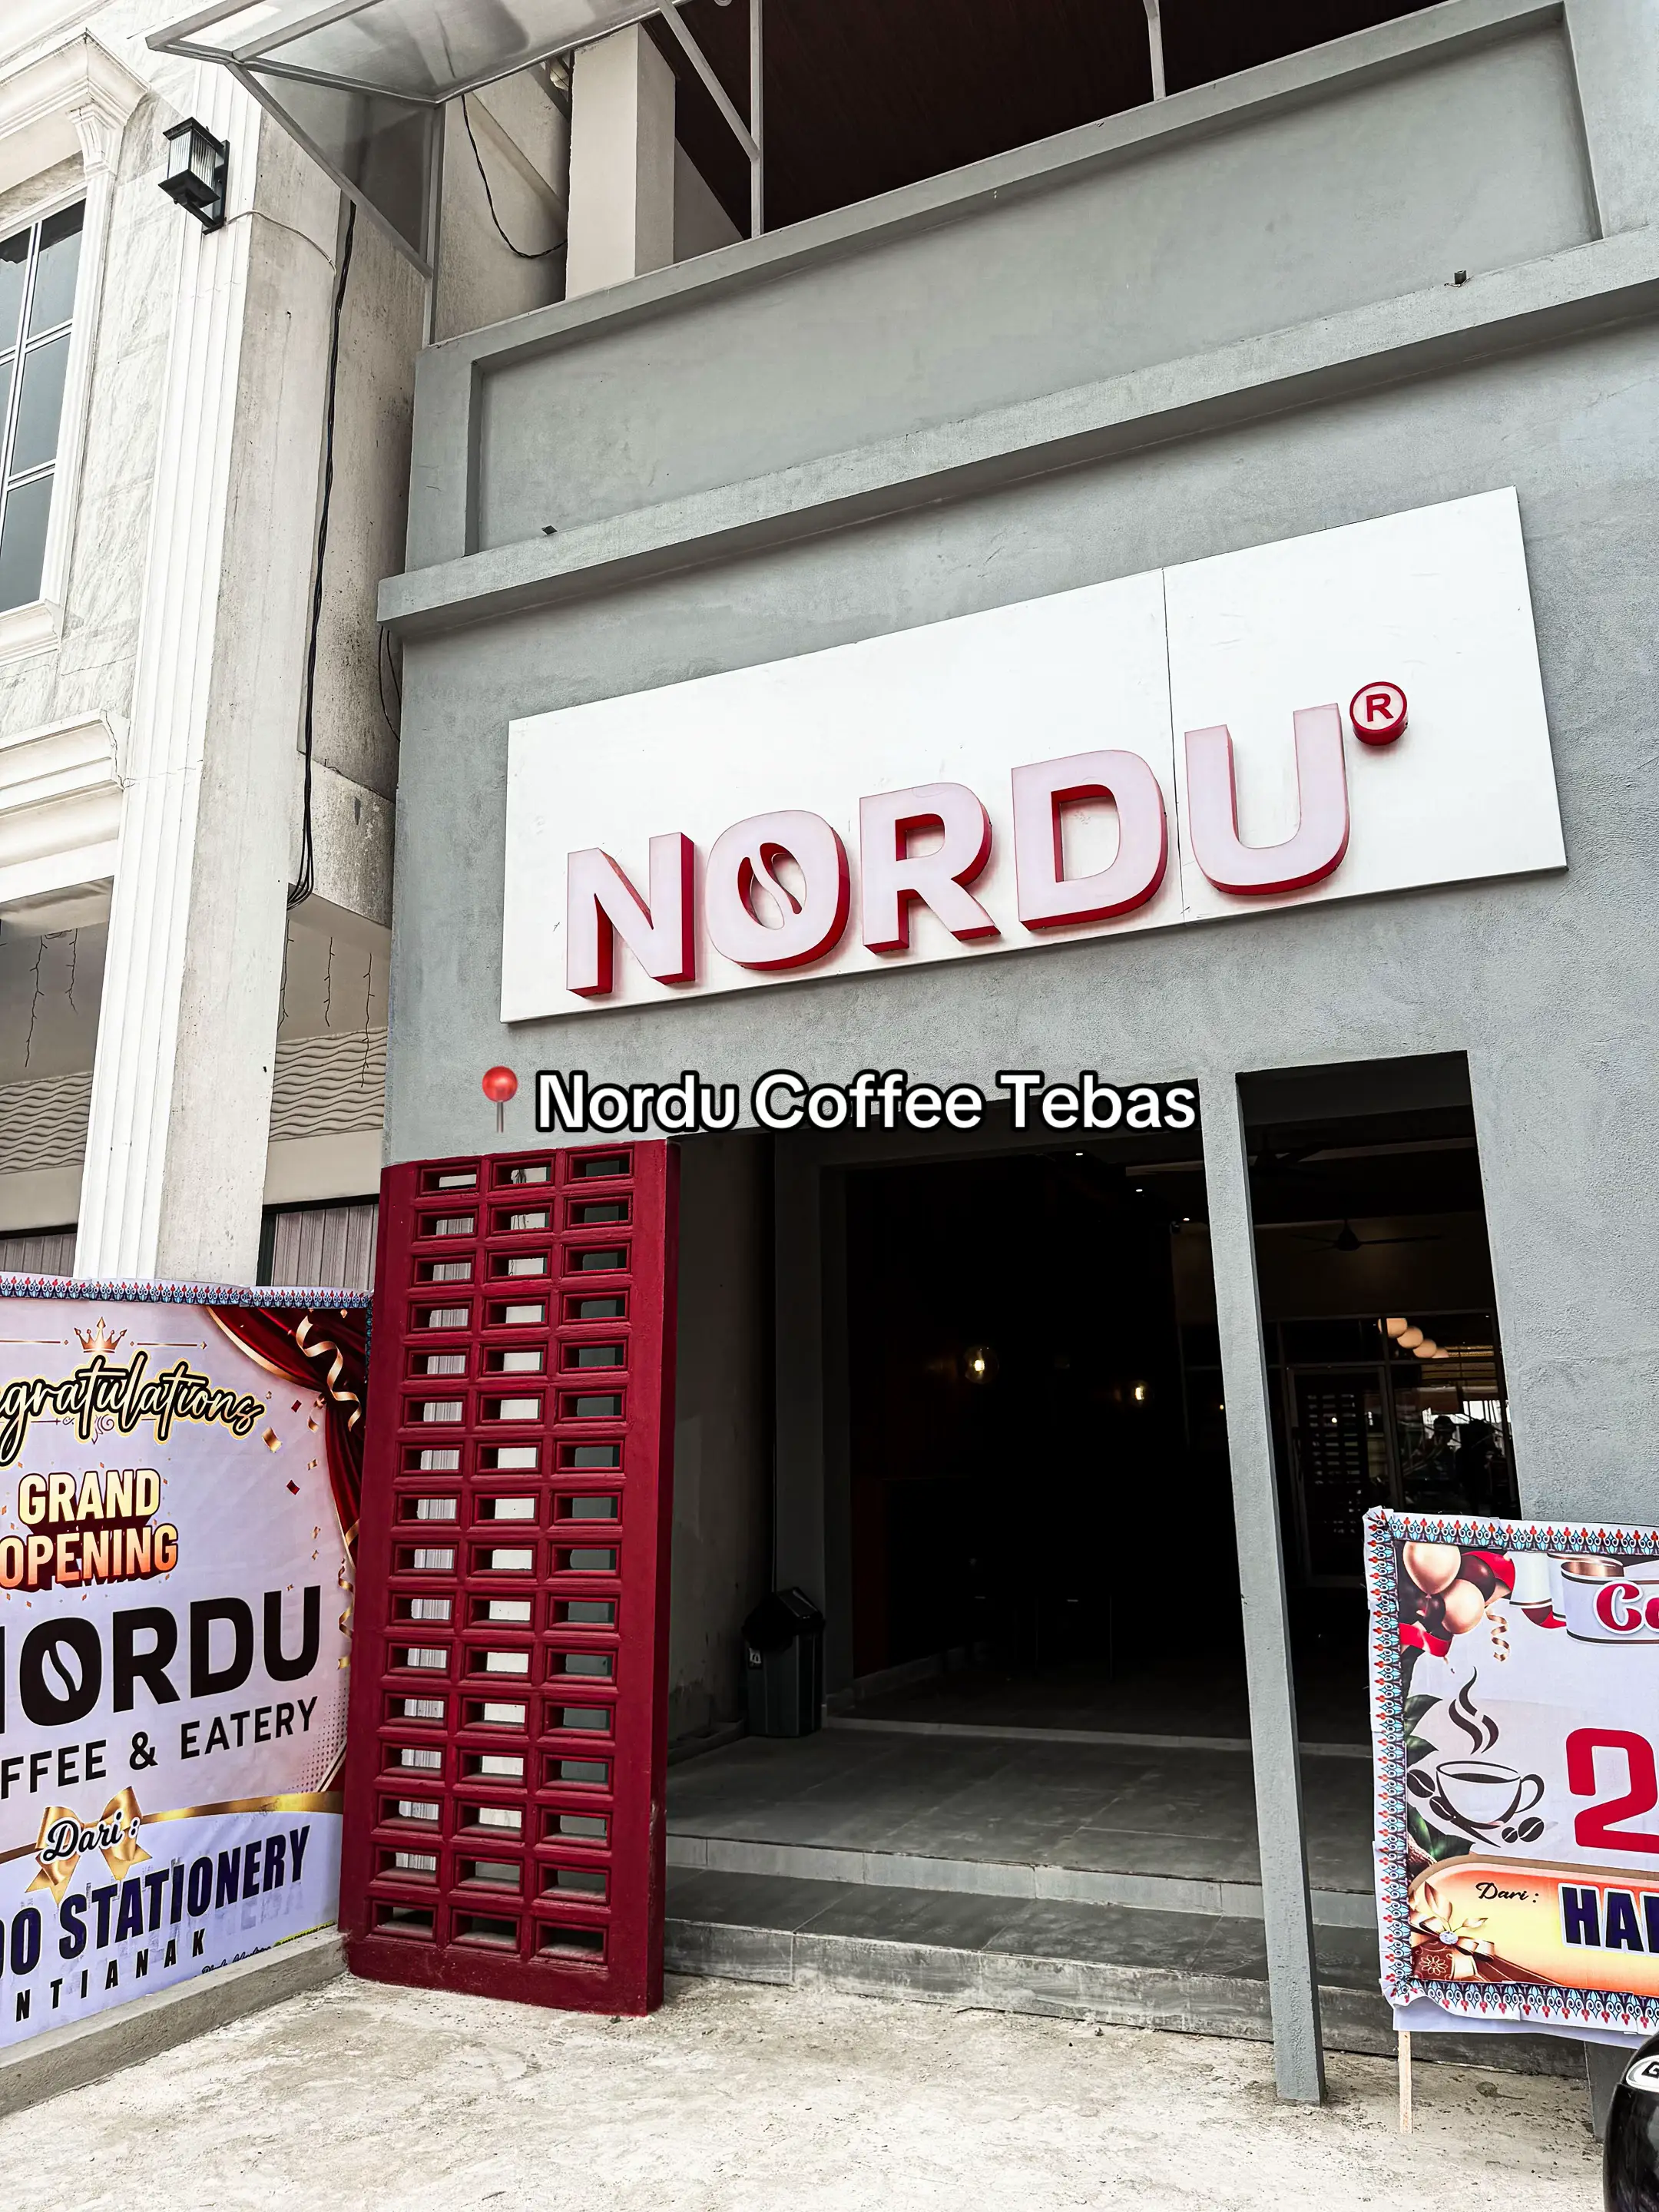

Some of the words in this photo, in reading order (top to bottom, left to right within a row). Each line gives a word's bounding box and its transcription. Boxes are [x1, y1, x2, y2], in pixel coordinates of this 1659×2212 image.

[566, 701, 1350, 997] NORDU
[18, 1469, 161, 1528] GRAND
[0, 1523, 179, 1591] OPENING
[0, 1585, 321, 1734] ORDU
[1, 1739, 107, 1800] FFEE
[129, 1731, 158, 1770] &
[180, 1696, 318, 1760] EATERY
[43, 1811, 123, 1862] Dari
[0, 1907, 41, 1979] O
[58, 1825, 311, 1959] STATIONERY
[1475, 1882, 1529, 1901] Dari
[1561, 1886, 1659, 1954] HA
